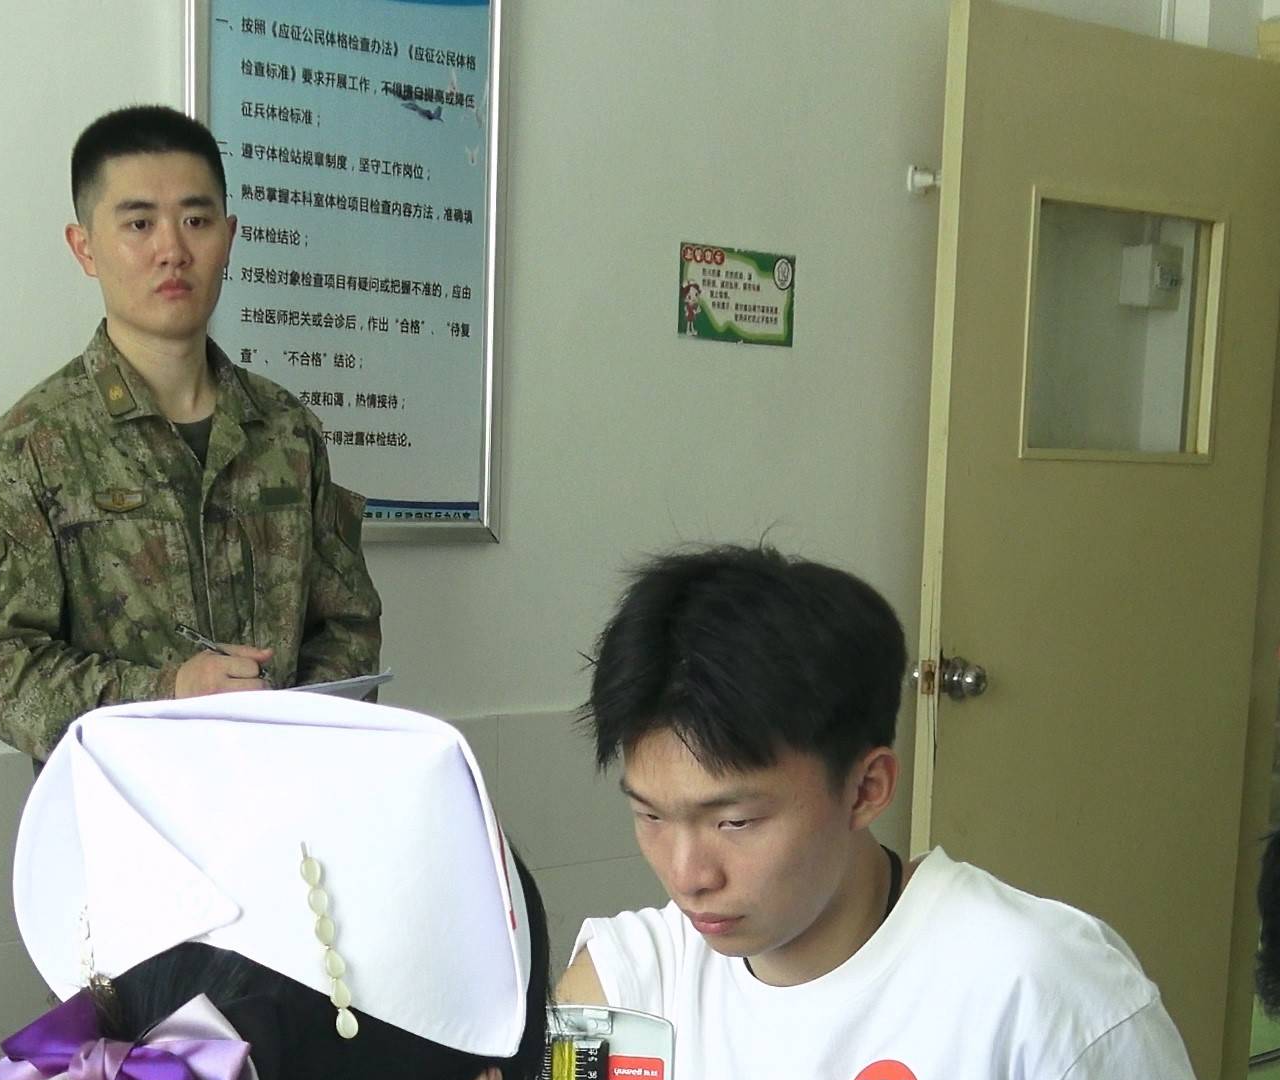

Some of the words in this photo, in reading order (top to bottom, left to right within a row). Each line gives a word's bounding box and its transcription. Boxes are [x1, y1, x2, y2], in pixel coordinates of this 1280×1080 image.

[241, 102, 321, 127] 征兵体检标准；
[226, 183, 473, 225] 、熟悉掌握本科室体检项目检查内容方法，准确填
[240, 225, 309, 247] 写体检结论；
